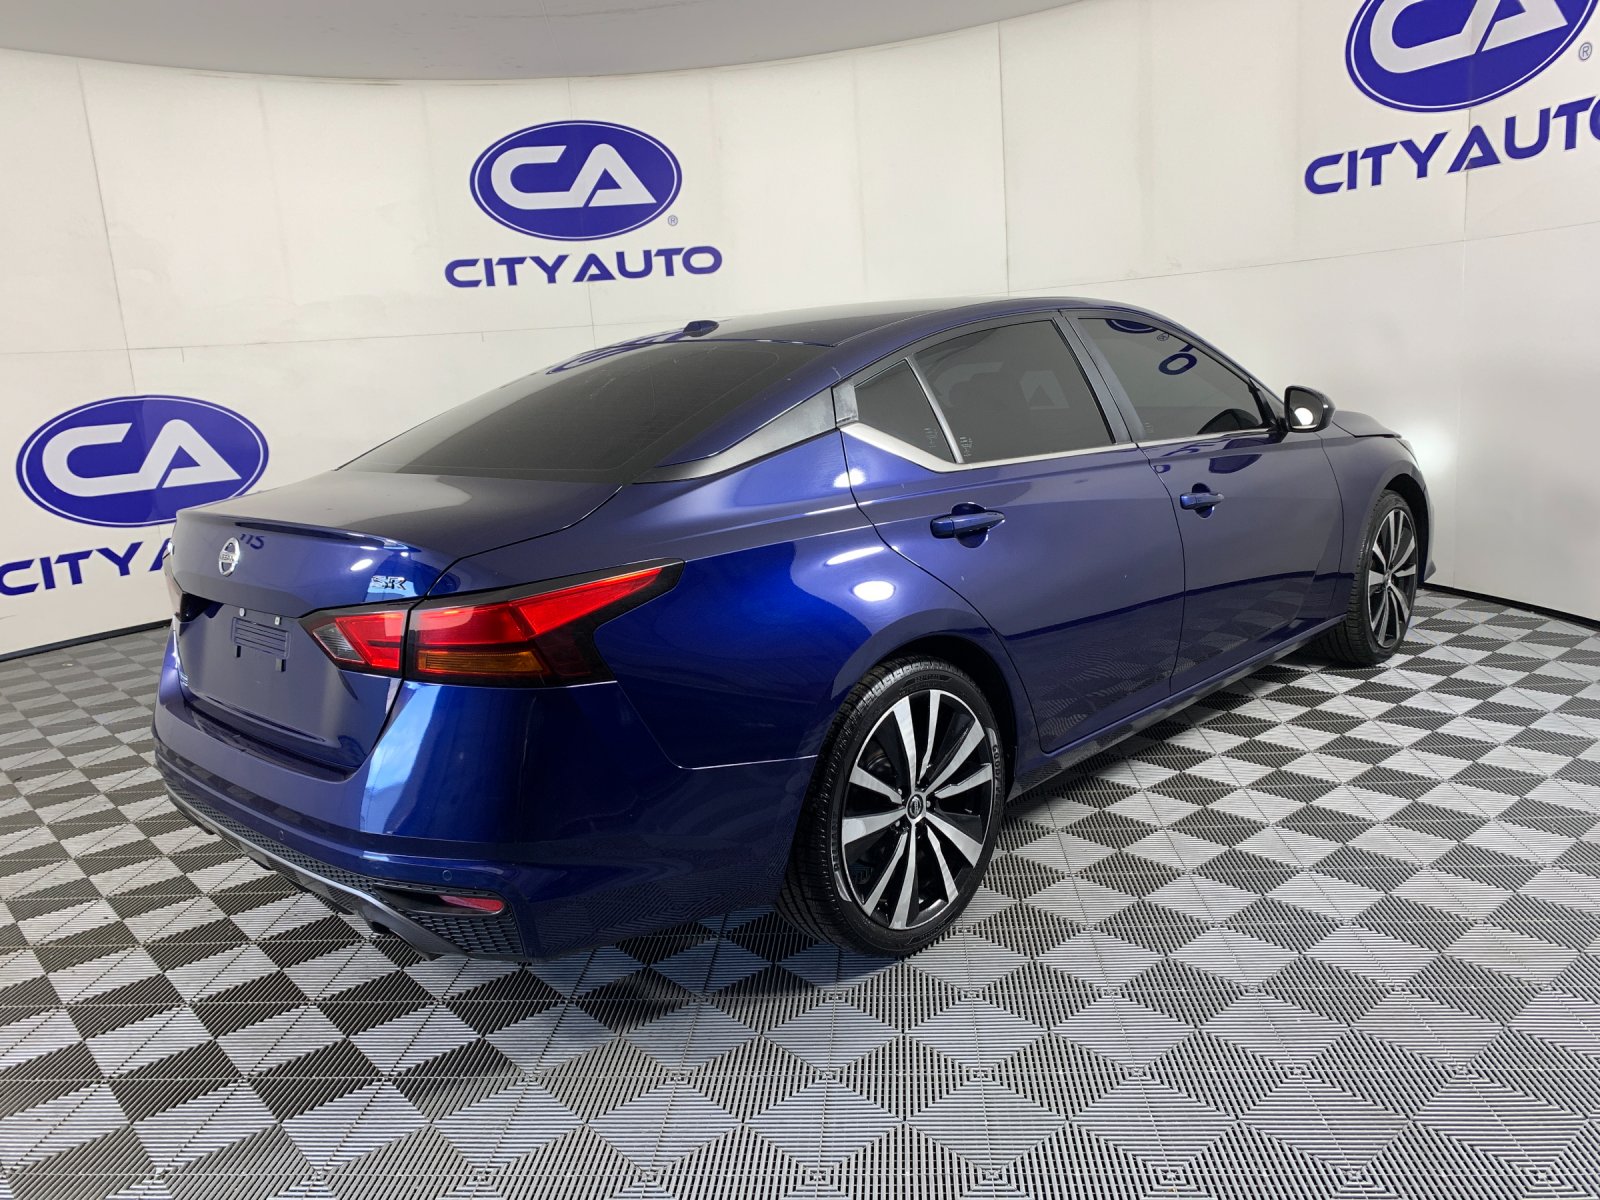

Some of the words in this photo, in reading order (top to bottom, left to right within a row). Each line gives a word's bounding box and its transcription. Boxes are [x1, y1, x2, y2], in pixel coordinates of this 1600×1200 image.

[491, 143, 657, 210] CA
[1304, 131, 1450, 195] CITY
[1447, 96, 1600, 174] AUT
[445, 254, 570, 288] CITY
[572, 246, 723, 283] AUTO
[42, 418, 242, 497] CA
[0, 541, 144, 596] CITY
